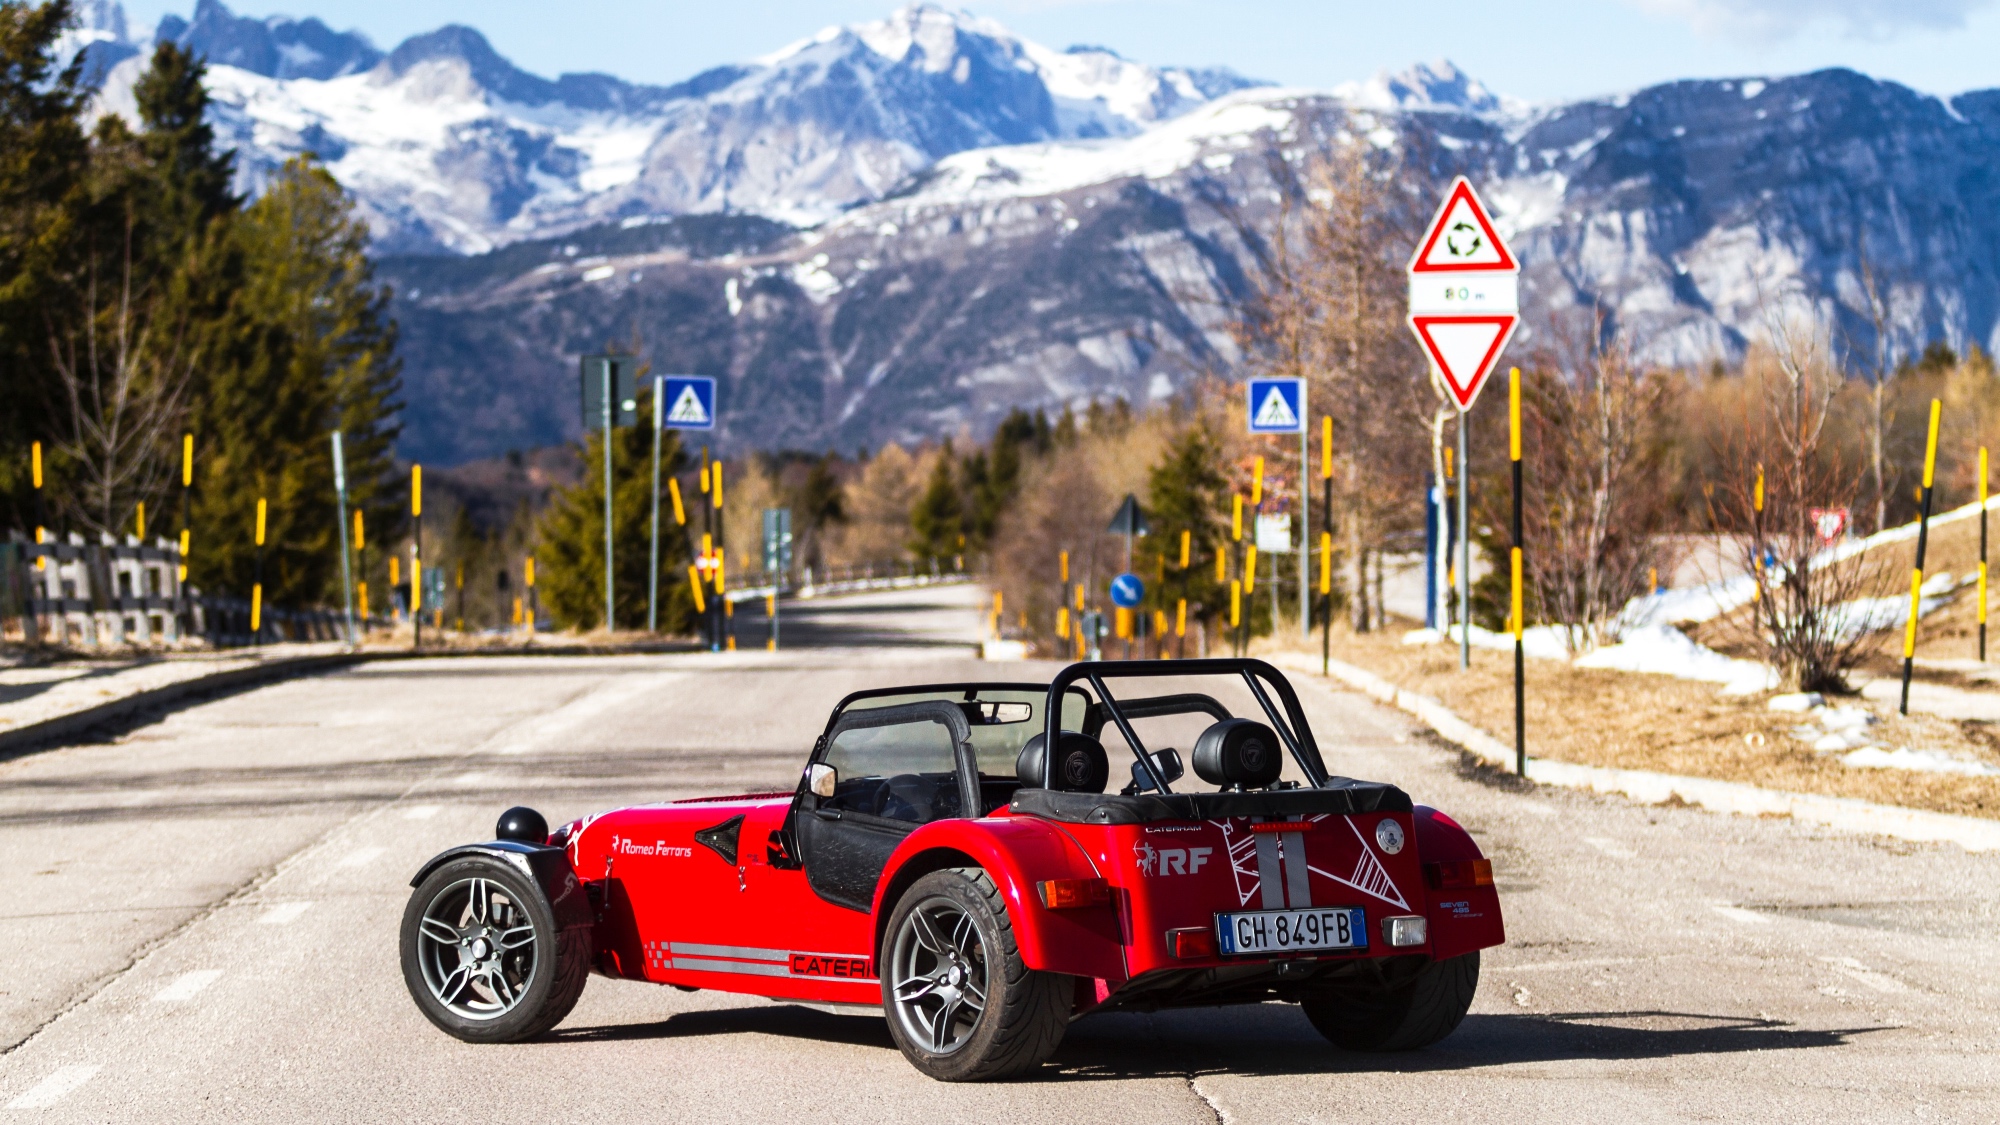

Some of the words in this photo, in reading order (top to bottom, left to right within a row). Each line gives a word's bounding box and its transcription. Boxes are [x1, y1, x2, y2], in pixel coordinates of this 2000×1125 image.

[1445, 287, 1469, 300] 80
[1145, 825, 1202, 833] CATERHAM
[620, 838, 655, 855] Romeo
[655, 840, 692, 857] Ferraris
[1158, 847, 1213, 876] RF
[793, 955, 870, 977] CATER
